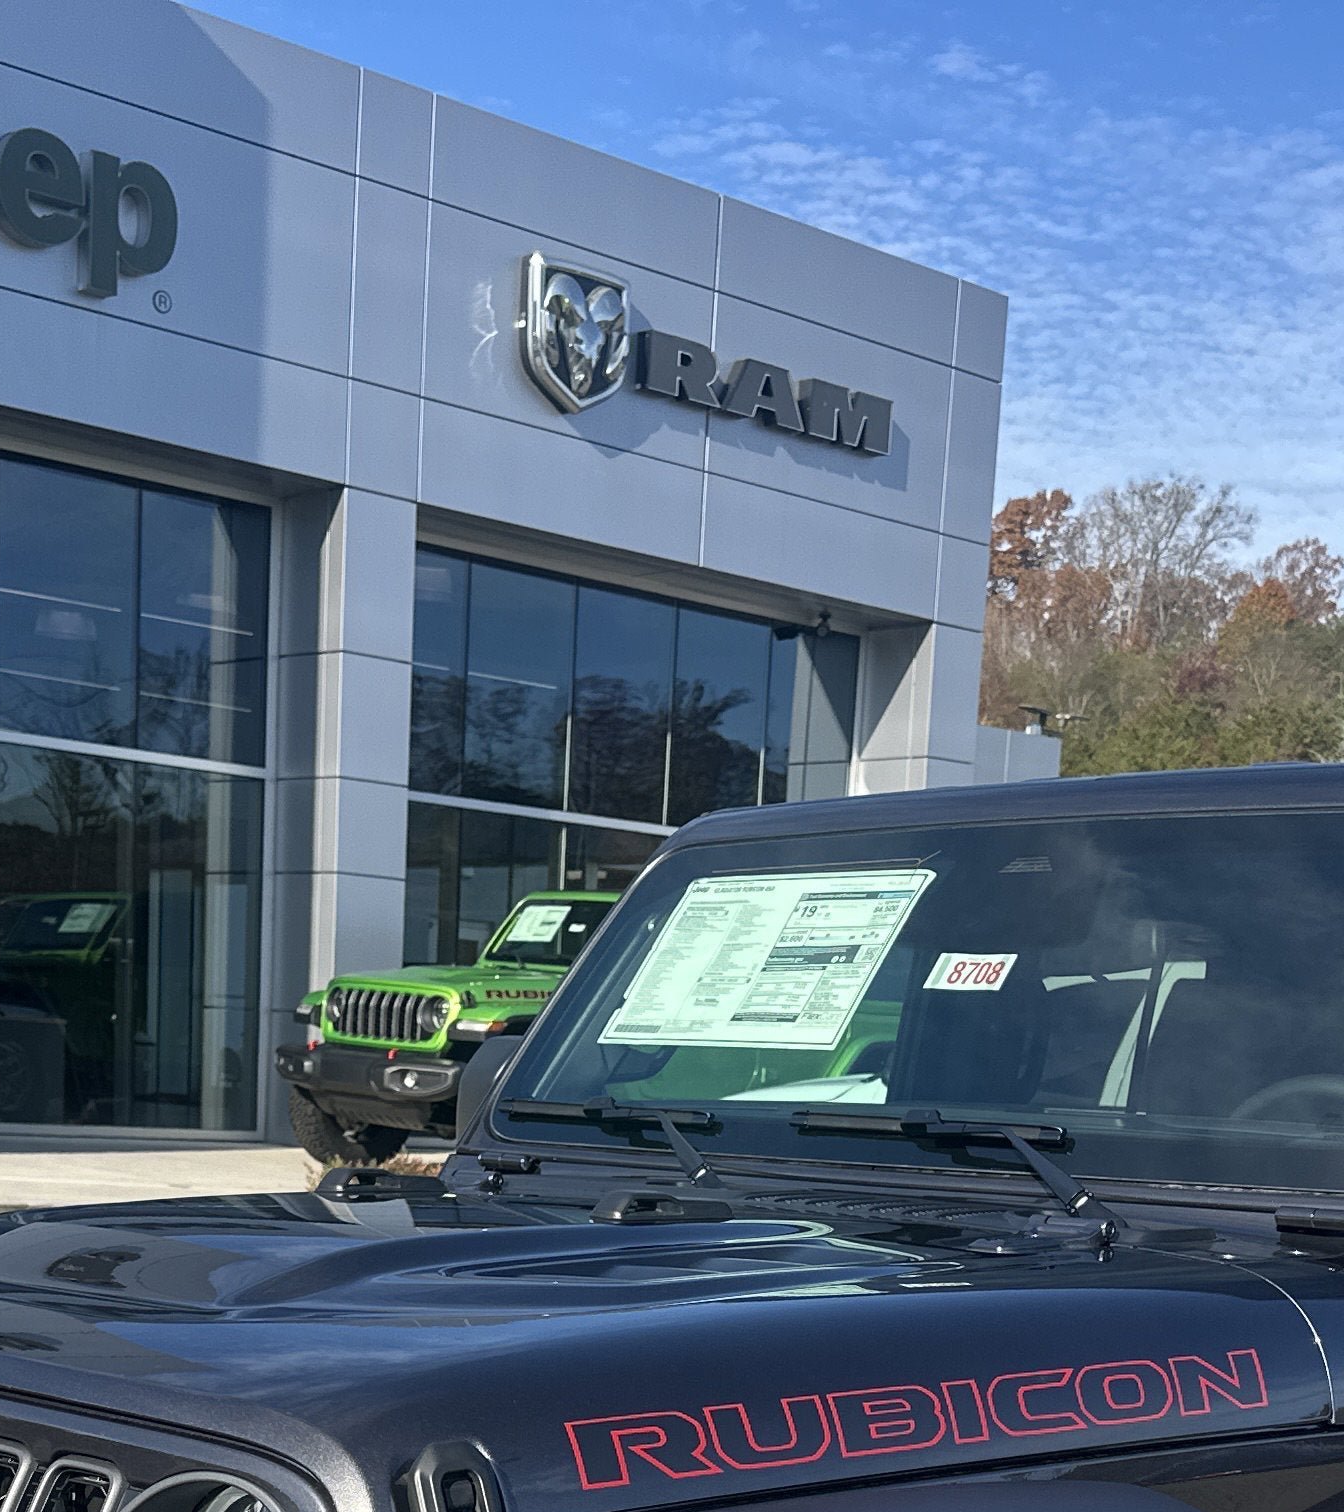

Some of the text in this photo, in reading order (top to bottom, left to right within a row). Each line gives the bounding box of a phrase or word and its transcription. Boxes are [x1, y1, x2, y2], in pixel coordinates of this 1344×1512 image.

[638, 328, 894, 457] RAM
[485, 989, 553, 1000] RUBI
[947, 961, 1006, 985] 8708
[563, 1348, 1269, 1491] RUBICON
